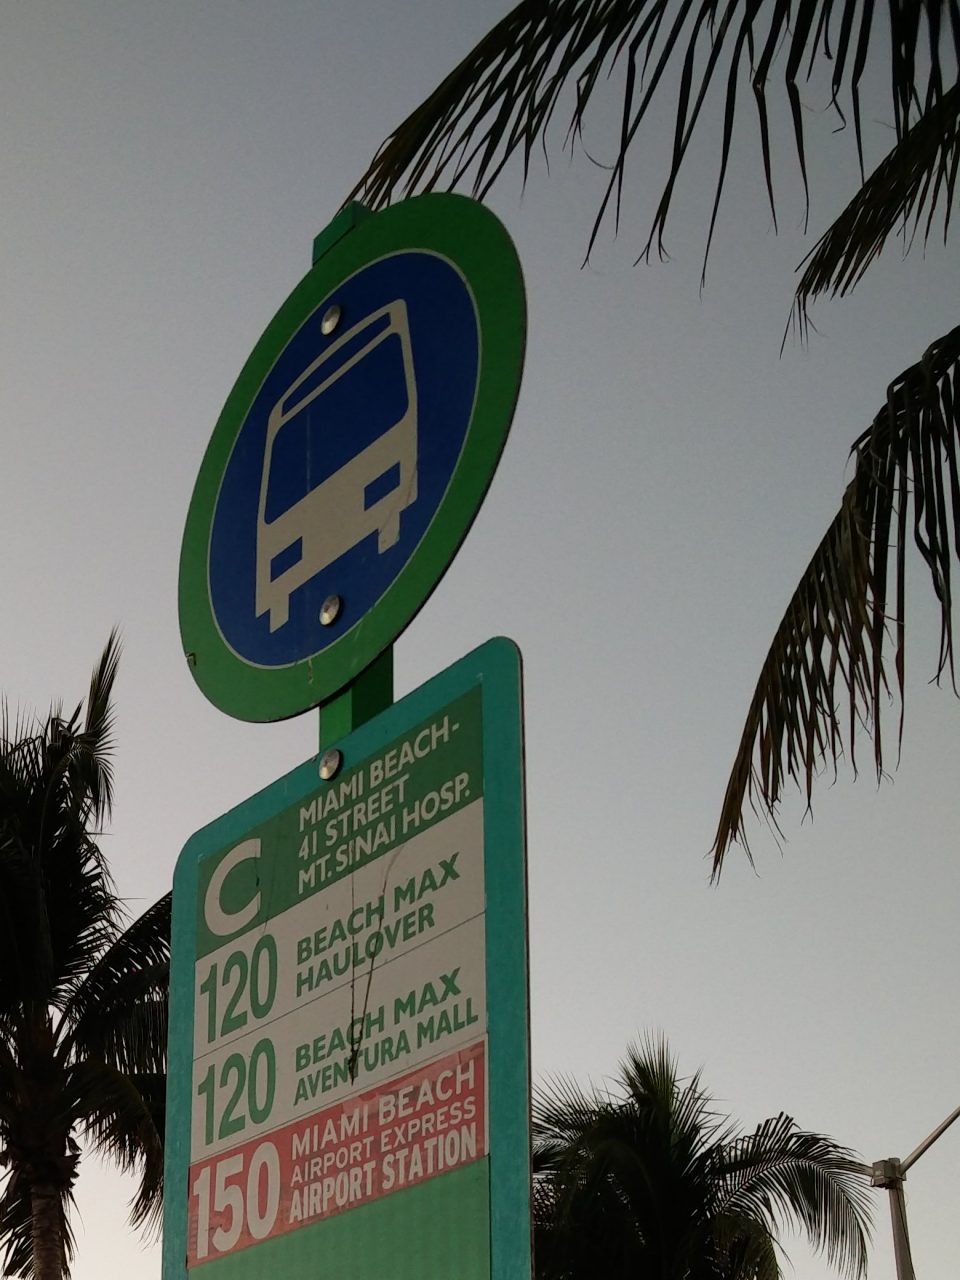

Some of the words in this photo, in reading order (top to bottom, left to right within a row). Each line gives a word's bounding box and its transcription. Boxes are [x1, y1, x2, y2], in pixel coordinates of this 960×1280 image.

[298, 835, 317, 860] 41
[325, 774, 411, 846] STREET
[299, 770, 364, 832] MIAMI
[370, 715, 460, 783] BEACH-
[298, 861, 333, 894] MT.
[336, 820, 396, 873] SINAI
[403, 772, 471, 834] HOSP.
[204, 838, 261, 936] C
[297, 896, 385, 965] BEACH
[394, 852, 460, 913] MAX
[200, 934, 278, 1044] 120
[296, 903, 435, 997] HAULOVER
[293, 1029, 411, 1106] AVENTURA
[417, 997, 479, 1050] MALL
[295, 1005, 385, 1073] BEACH
[394, 967, 462, 1025] MAX
[197, 1038, 276, 1146] 120
[290, 1136, 374, 1187] AIRPORT
[381, 1099, 476, 1152] EXPRESS
[291, 1108, 369, 1161] MIAMI
[378, 1059, 475, 1127] BEACH
[193, 1142, 281, 1260] 150
[289, 1158, 375, 1224] AIRPORT
[382, 1122, 477, 1190] STATION
